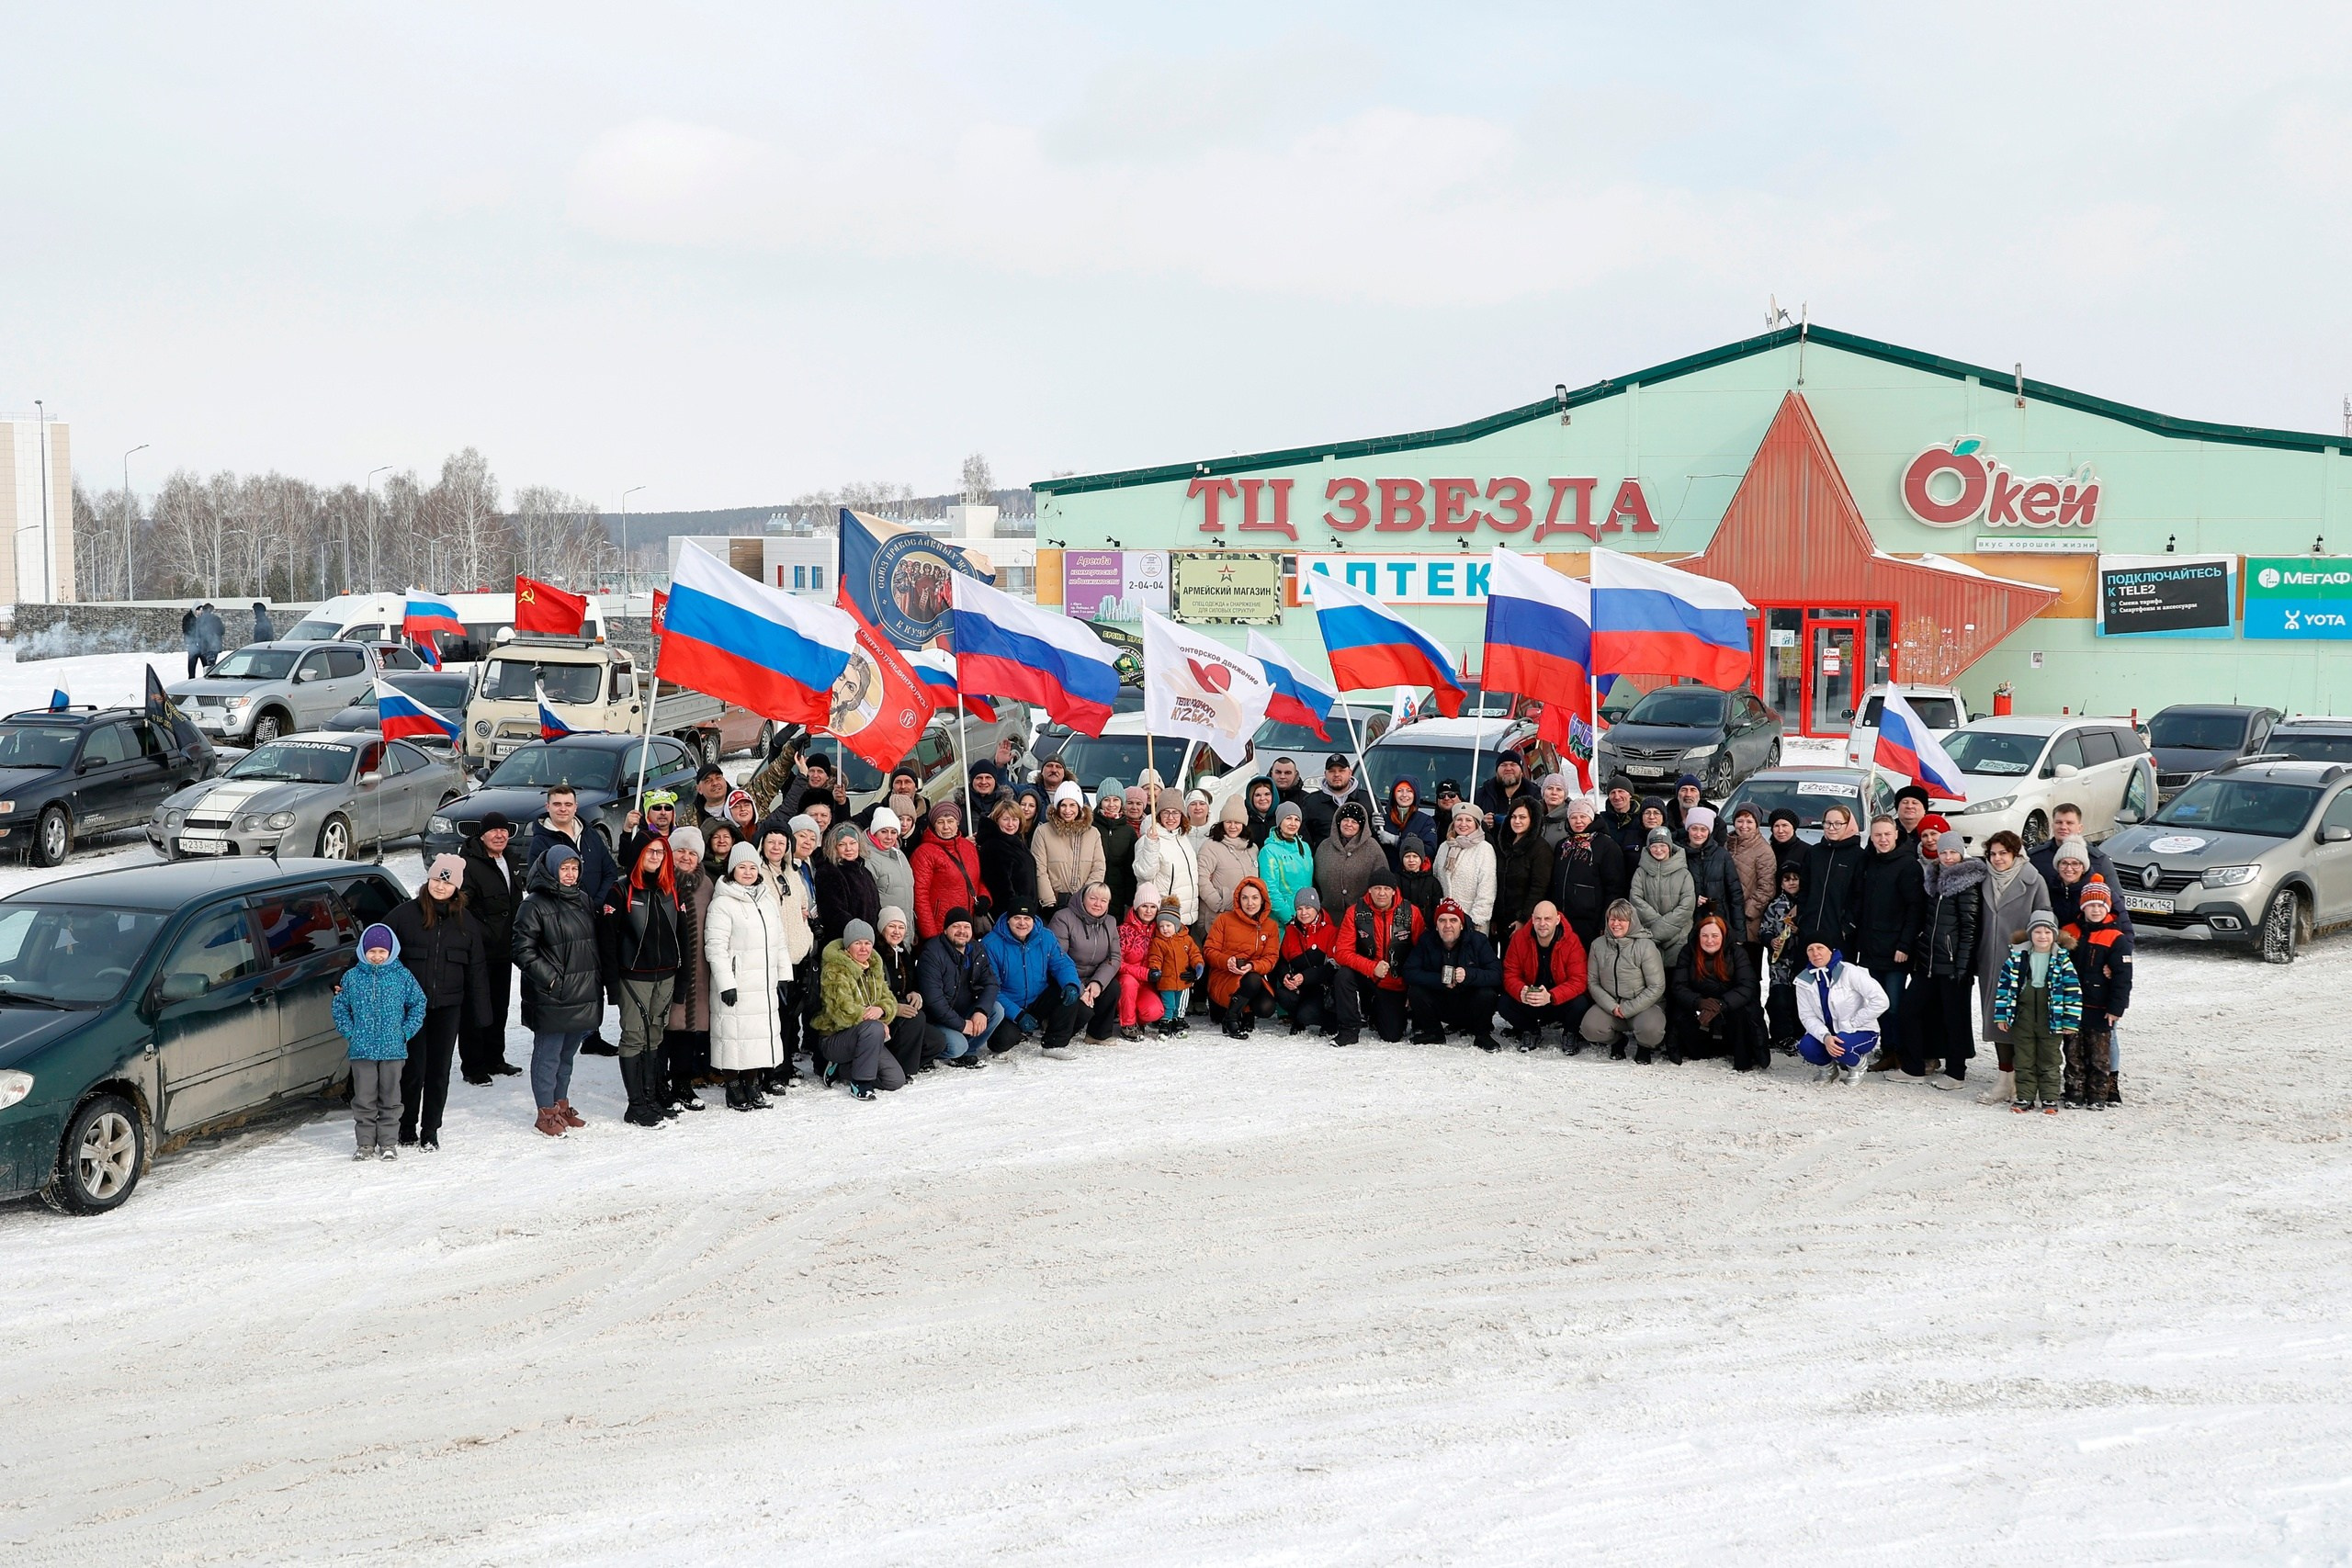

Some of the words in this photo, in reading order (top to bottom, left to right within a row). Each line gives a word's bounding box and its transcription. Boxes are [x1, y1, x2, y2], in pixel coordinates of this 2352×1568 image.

[1186, 477, 1299, 541] ТЦ
[1323, 476, 1659, 543] ЗВЕЗДА
[1978, 540, 2003, 549] вкус
[2008, 539, 2056, 549] хорошей
[2062, 540, 2096, 549] жизни
[878, 560, 889, 589] СОЮЗ
[886, 538, 958, 561] ПРАВОСЛАВНЫХ
[1077, 555, 1112, 567] Аренда
[1069, 568, 1118, 577] коммерческой
[2107, 567, 2222, 586] ПОДКЛЮЧАЙТЕСЬ
[2283, 571, 2352, 584] МЕГАФ
[1303, 561, 1491, 597] АПТЕК
[1128, 581, 1164, 590] 2-04-04
[1183, 584, 1231, 595] АРМЕЙСКИЙ
[1233, 587, 1272, 596] МАГАЗИН
[2108, 586, 2117, 597] К
[2119, 584, 2156, 597] TELE2
[2139, 598, 2163, 606] тарифа
[2119, 605, 2156, 614] Смартфоны
[2162, 603, 2199, 611] аксессуары
[2303, 614, 2346, 626] YOTA
[860, 629, 884, 656] СВЯТУЮ
[882, 653, 917, 693] ТРИЕДИНУЮ
[1177, 645, 1221, 661] онтерское
[1221, 659, 1259, 685] движение
[265, 741, 353, 752] SPEEDHUNTERS
[84, 815, 106, 825] TOYOTA
[2125, 897, 2155, 910] 881КК
